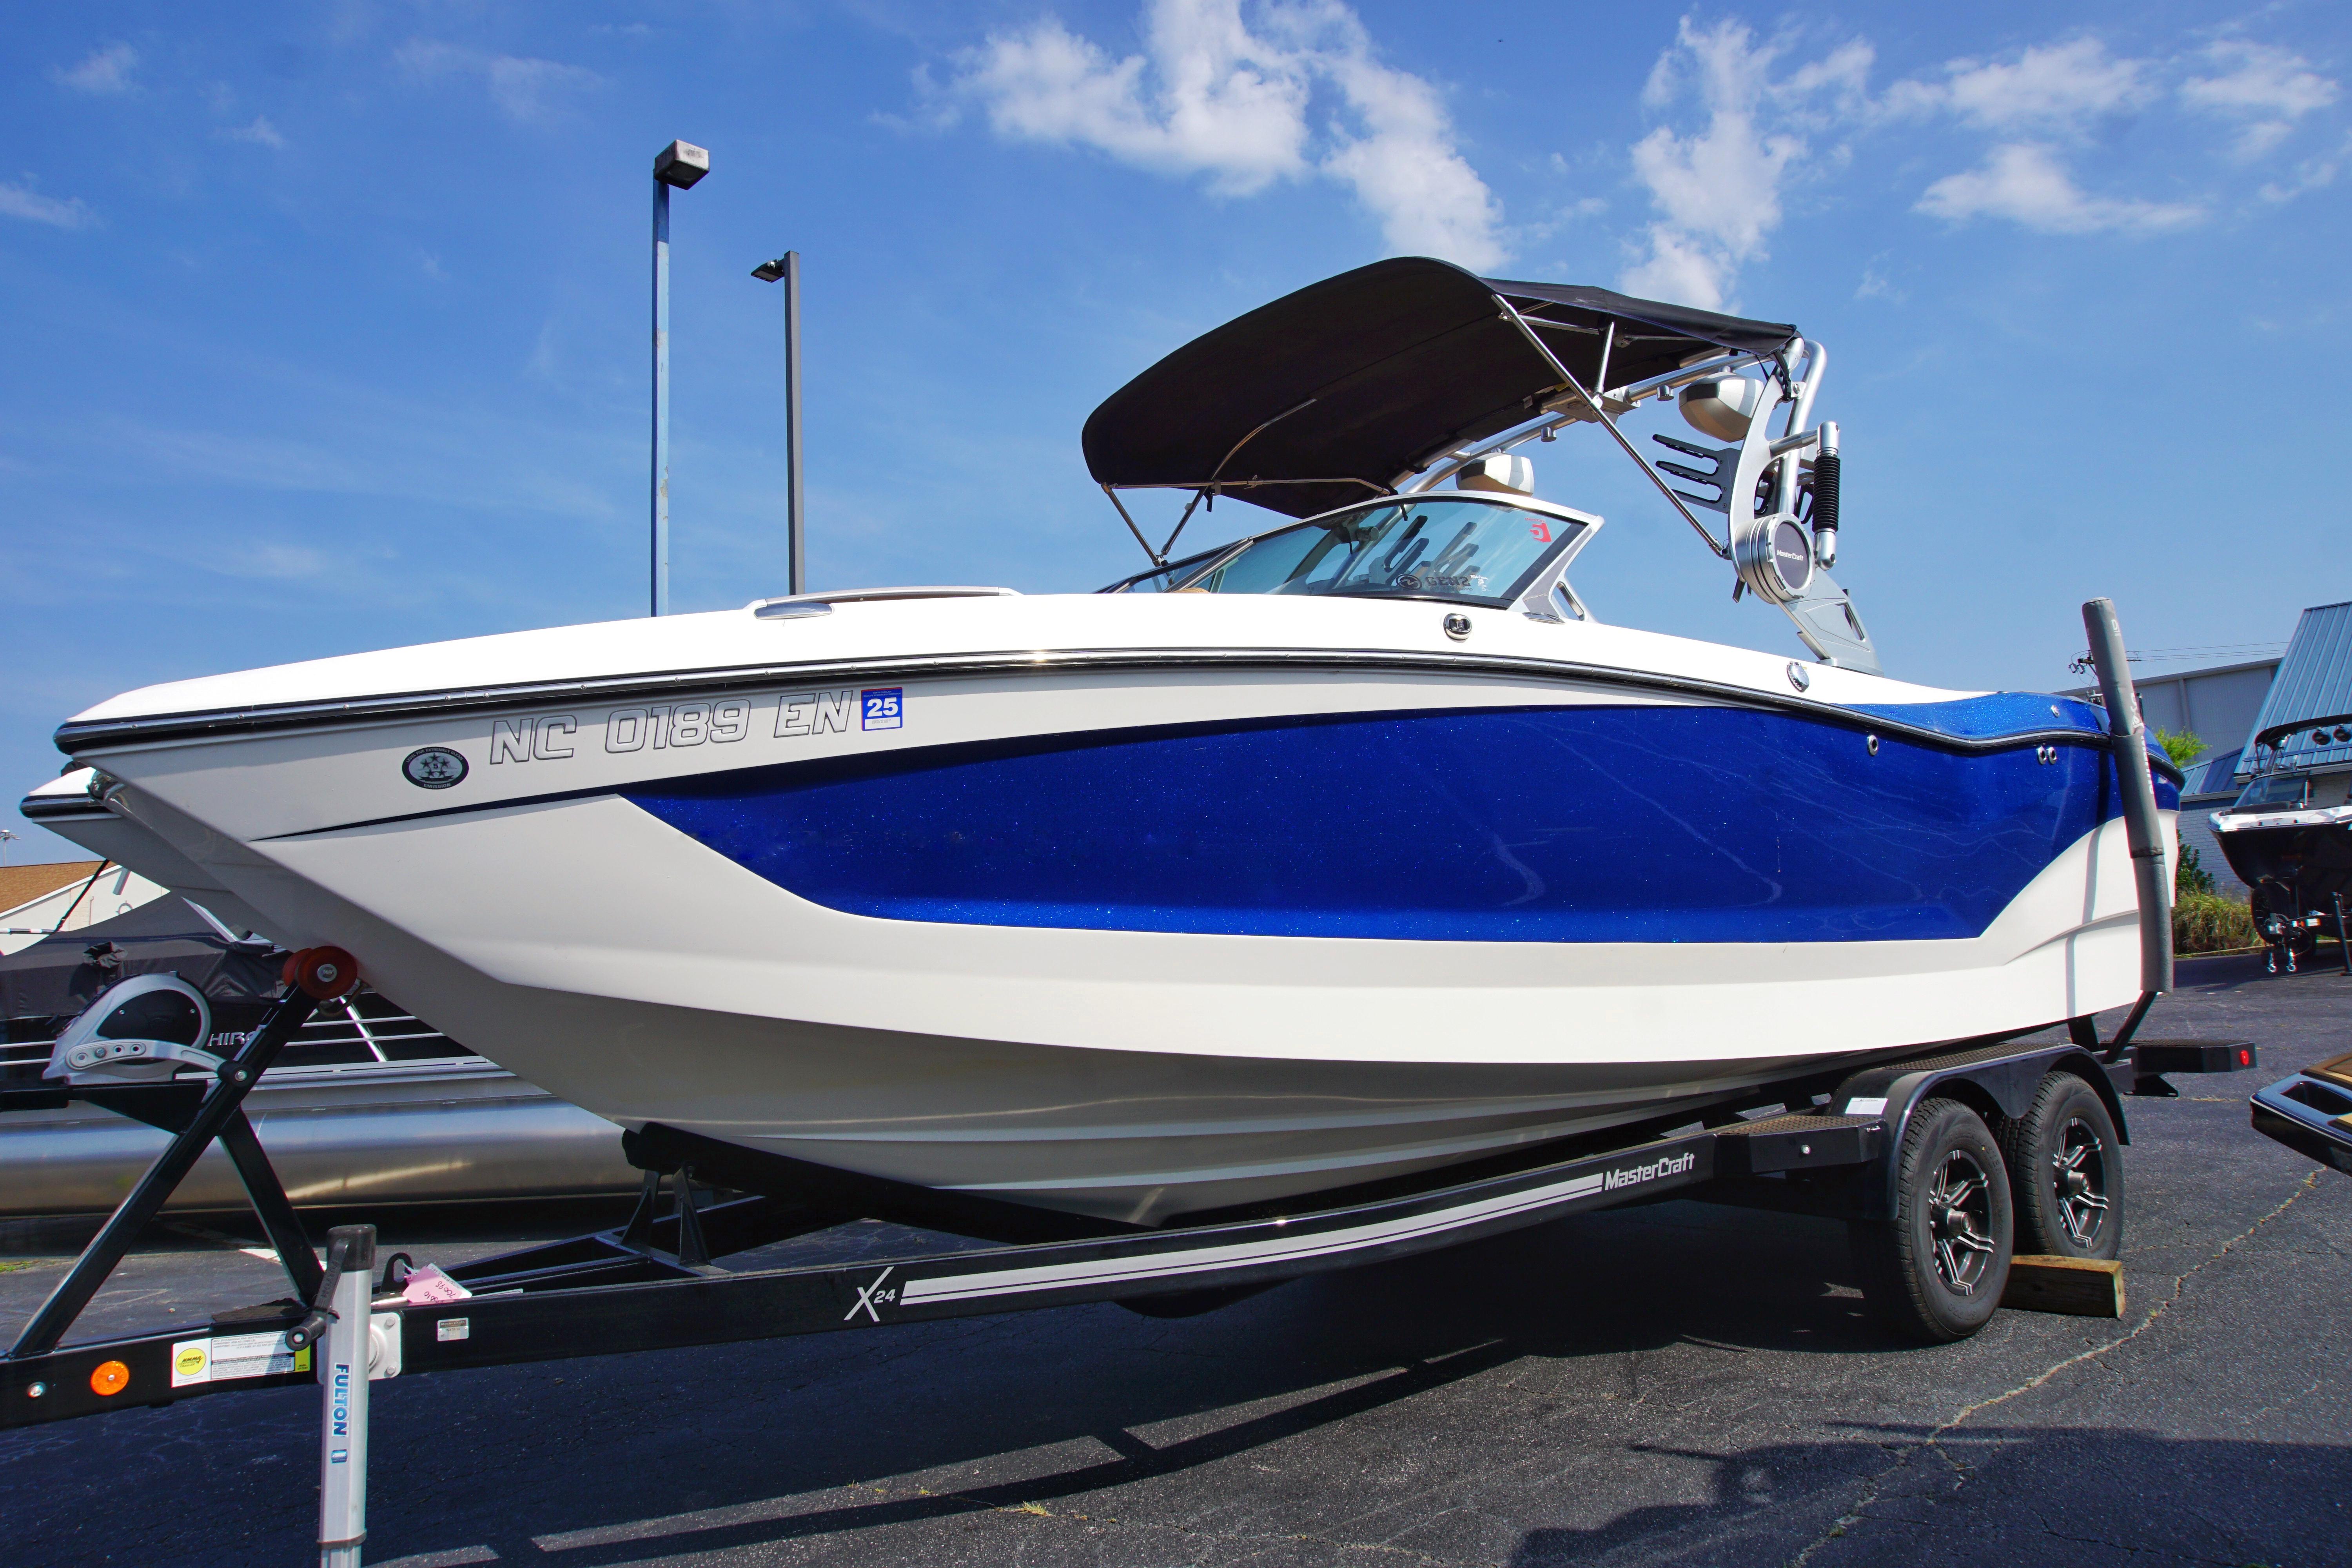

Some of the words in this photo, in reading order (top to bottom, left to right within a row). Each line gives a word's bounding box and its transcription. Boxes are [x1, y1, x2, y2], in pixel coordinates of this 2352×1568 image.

[1777, 549, 1804, 561] MasterCraft
[867, 697, 898, 717] 25
[490, 715, 577, 765] NC
[605, 699, 751, 754] 0189
[773, 690, 854, 738] EN
[406, 753, 416, 763] LEVEL
[451, 751, 463, 760] CLEAN
[1605, 1152, 1695, 1191] MasterCraft
[333, 1364, 350, 1436] FULTON
